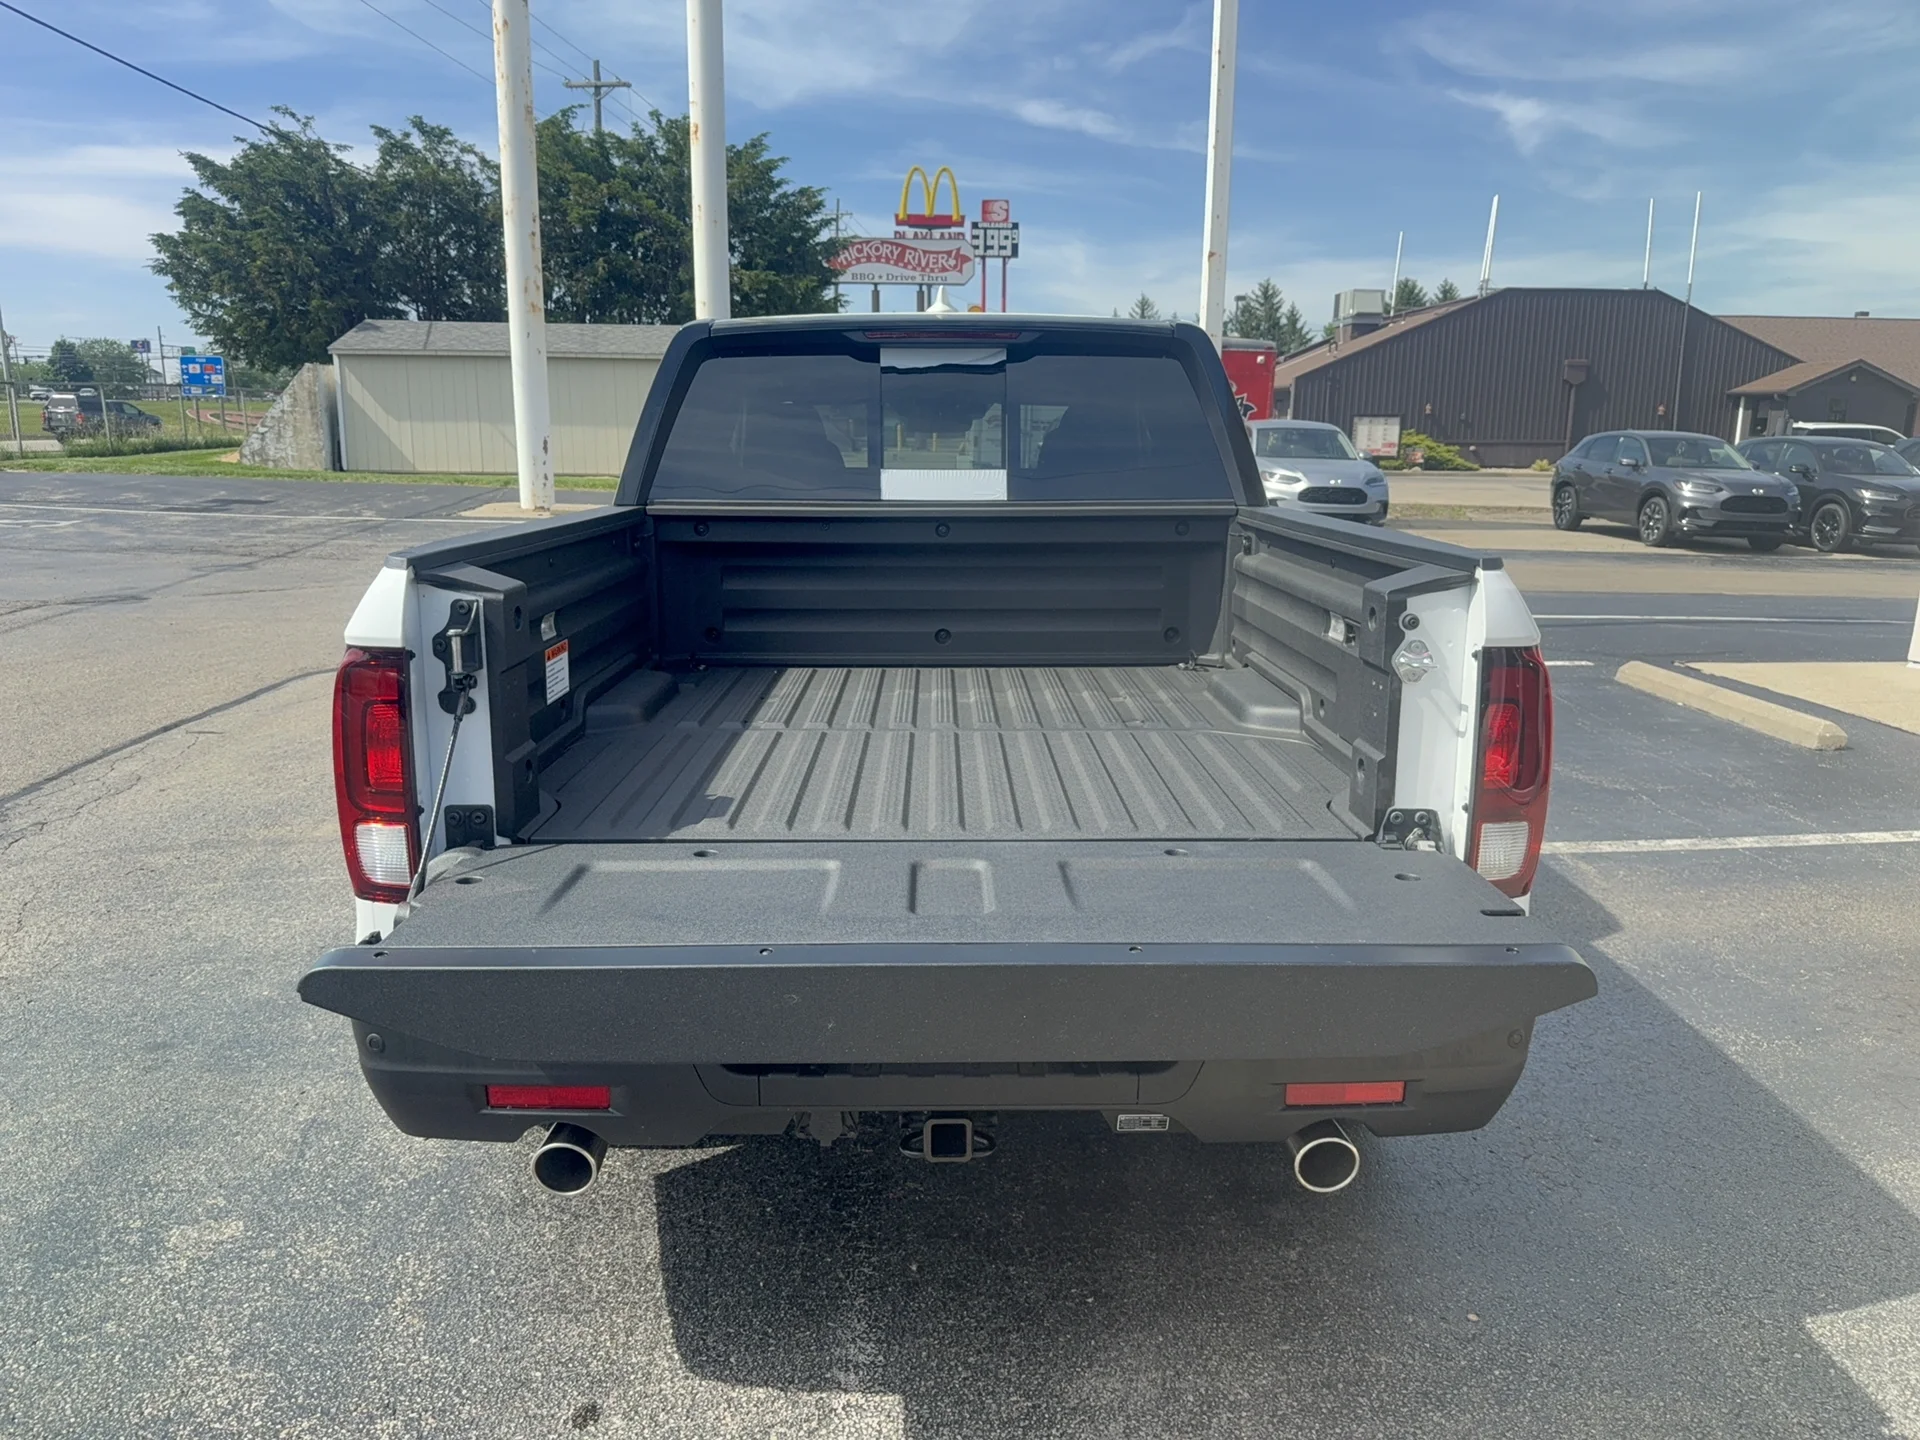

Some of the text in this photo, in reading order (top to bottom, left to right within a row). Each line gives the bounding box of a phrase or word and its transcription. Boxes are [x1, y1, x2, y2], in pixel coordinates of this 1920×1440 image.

[837, 240, 902, 265] HICKORY
[851, 272, 948, 282] BBQ Drive Thru
